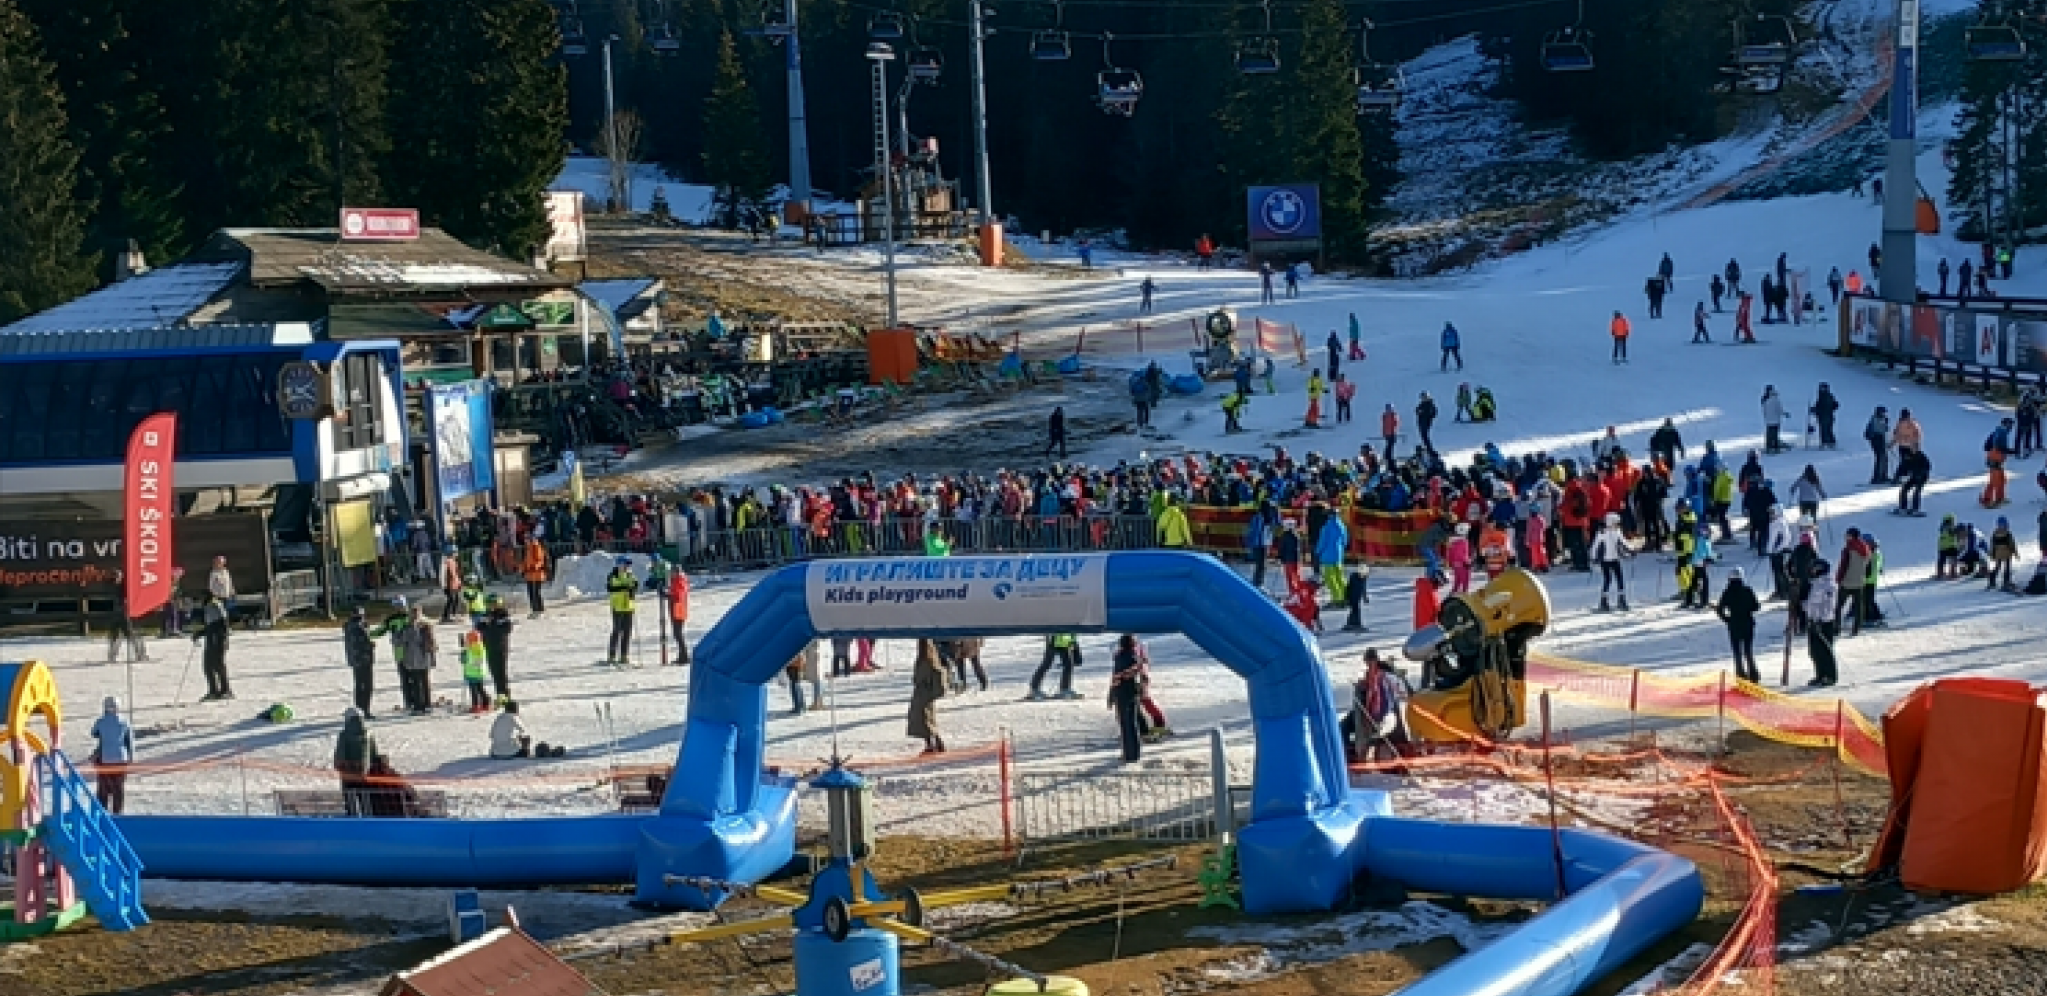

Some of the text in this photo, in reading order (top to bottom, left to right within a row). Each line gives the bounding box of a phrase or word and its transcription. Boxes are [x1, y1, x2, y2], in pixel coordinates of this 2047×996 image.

[140, 459, 163, 587] SKI ŠKOLA
[48, 540, 84, 557] na
[93, 539, 122, 557] vr
[824, 557, 1088, 584] ИГРАЛИШТЕ ЗА ДЕЦУ
[824, 583, 970, 605] Kids playground
